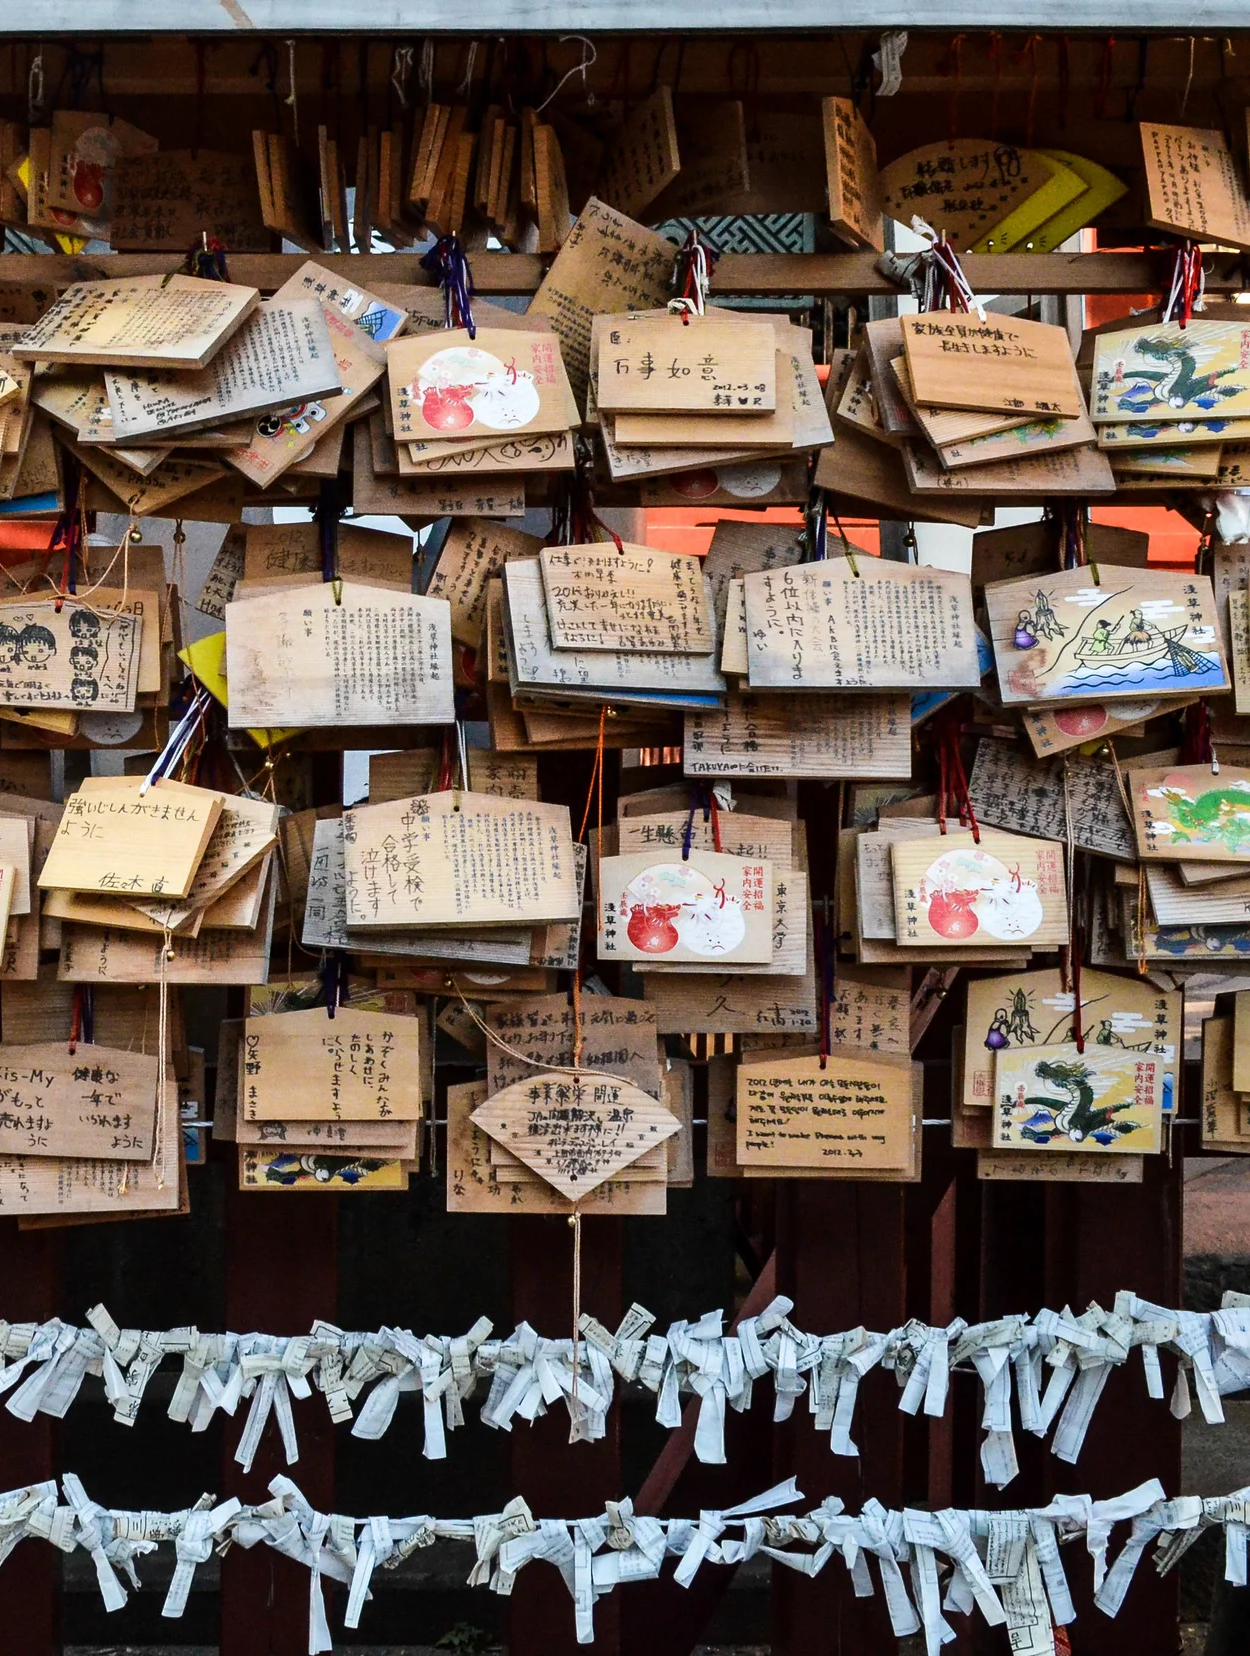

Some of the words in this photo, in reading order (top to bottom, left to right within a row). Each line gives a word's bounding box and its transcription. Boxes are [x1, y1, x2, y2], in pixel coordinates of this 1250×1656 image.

[613, 352, 719, 382] 万事如意
[398, 387, 412, 432] 浅草神社
[303, 609, 313, 637] 願い事
[763, 575, 785, 636] すように。
[780, 571, 804, 681] 6位以内に入りま
[950, 595, 963, 649] 浅草神社縁起
[1183, 584, 1206, 635] 浅草神社
[427, 622, 440, 681] 浅草神社縁起
[60, 819, 105, 840] ように
[67, 797, 201, 823] 強いじしんがきません
[381, 834, 401, 906] 合格して
[400, 811, 425, 912] 中学受検で
[548, 826, 562, 880] 浅草神社縁起
[98, 872, 144, 890] 佐々木
[742, 865, 753, 911] 家内安全
[753, 866, 765, 911] 開運招福
[604, 903, 617, 951] 浅草神社
[772, 882, 789, 950] 東京大学
[905, 888, 919, 938] 浅草神社
[1153, 999, 1168, 1054] 浅草神社
[245, 1048, 262, 1076] 矢野
[330, 1035, 345, 1120] くらせますよう
[349, 1033, 361, 1076] たのしく
[376, 1031, 394, 1118] かぞくみんなが
[81, 1092, 122, 1108] 一年で
[247, 1085, 258, 1120] まさき
[1134, 1062, 1145, 1105] 家内安全
[1144, 1062, 1156, 1105] 開運招福
[78, 1113, 133, 1129] いられます
[1000, 1095, 1012, 1142] 浅草神社
[28, 1135, 49, 1147] うに
[110, 1135, 144, 1150] ように
